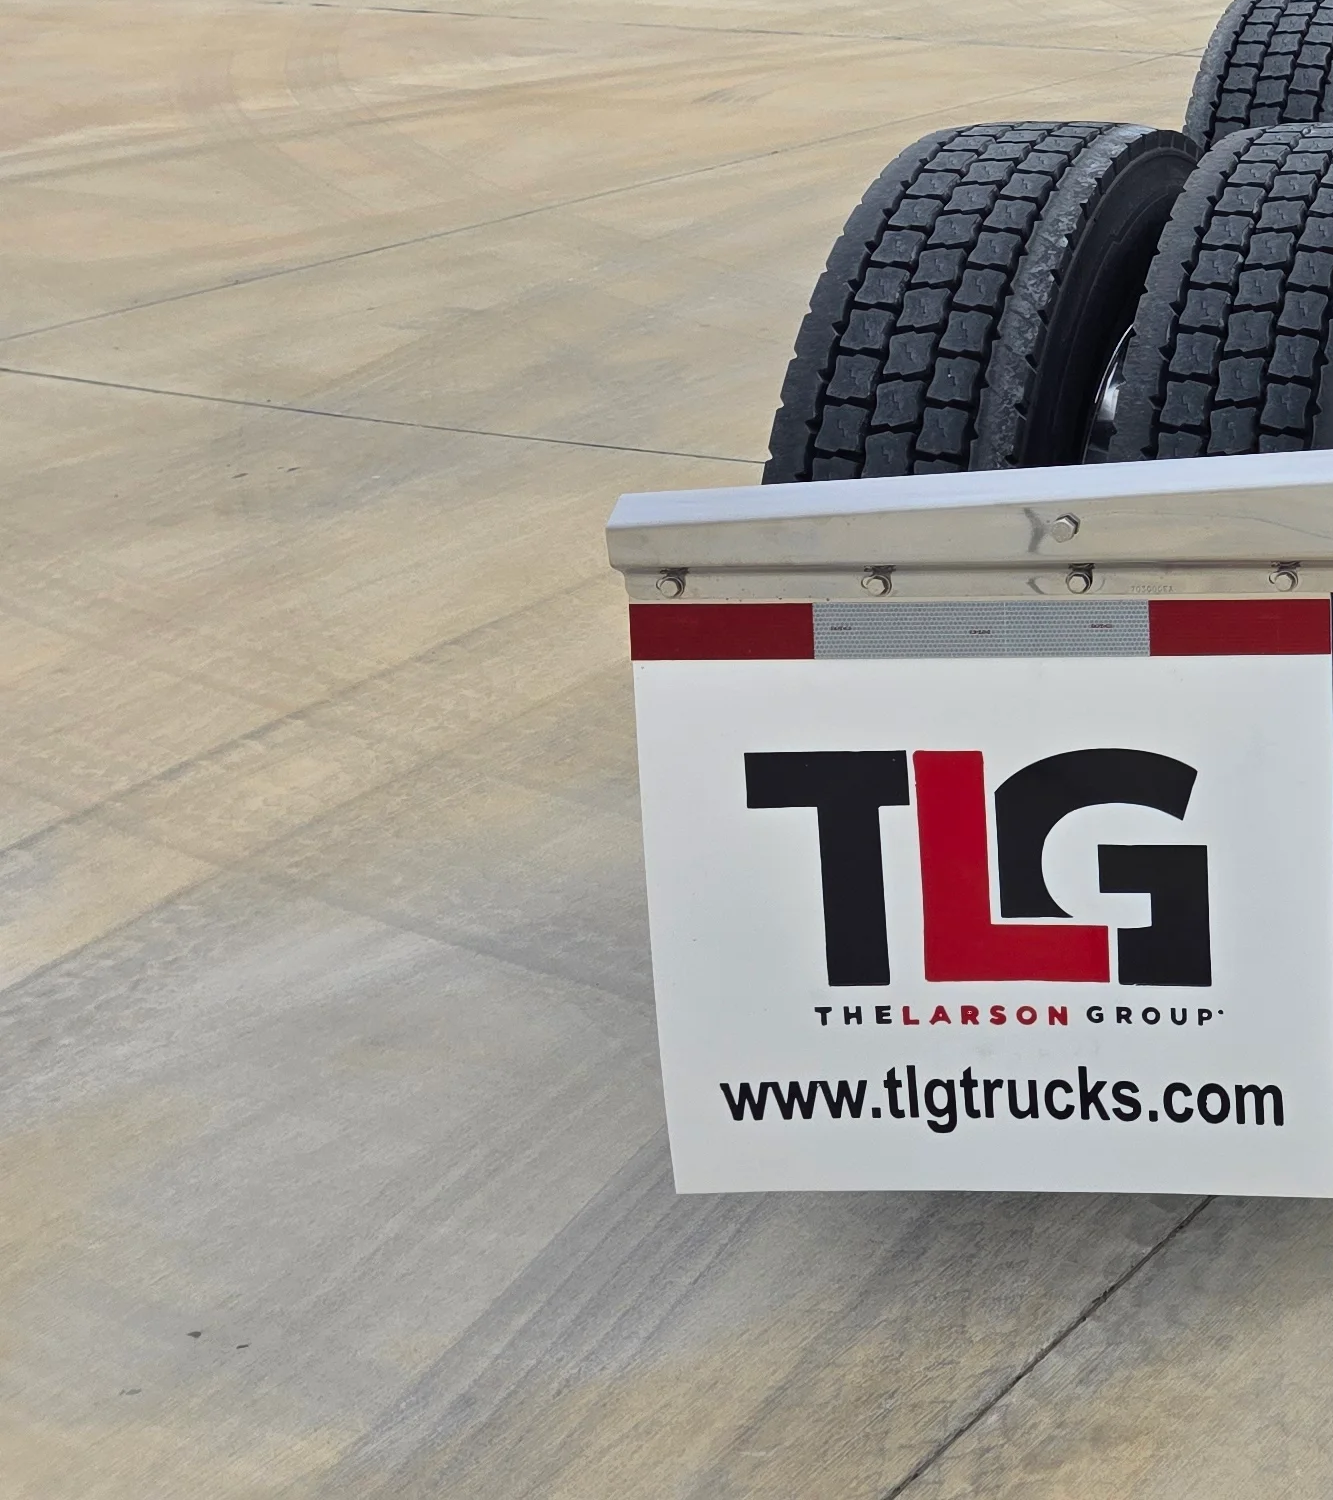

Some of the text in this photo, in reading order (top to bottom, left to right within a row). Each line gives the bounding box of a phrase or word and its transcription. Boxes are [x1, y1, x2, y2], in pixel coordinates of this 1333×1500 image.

[744, 748, 1212, 987] TLG
[1087, 1005, 1214, 1027] GROUP
[720, 1065, 1284, 1133] www.tlgtrucks.com
